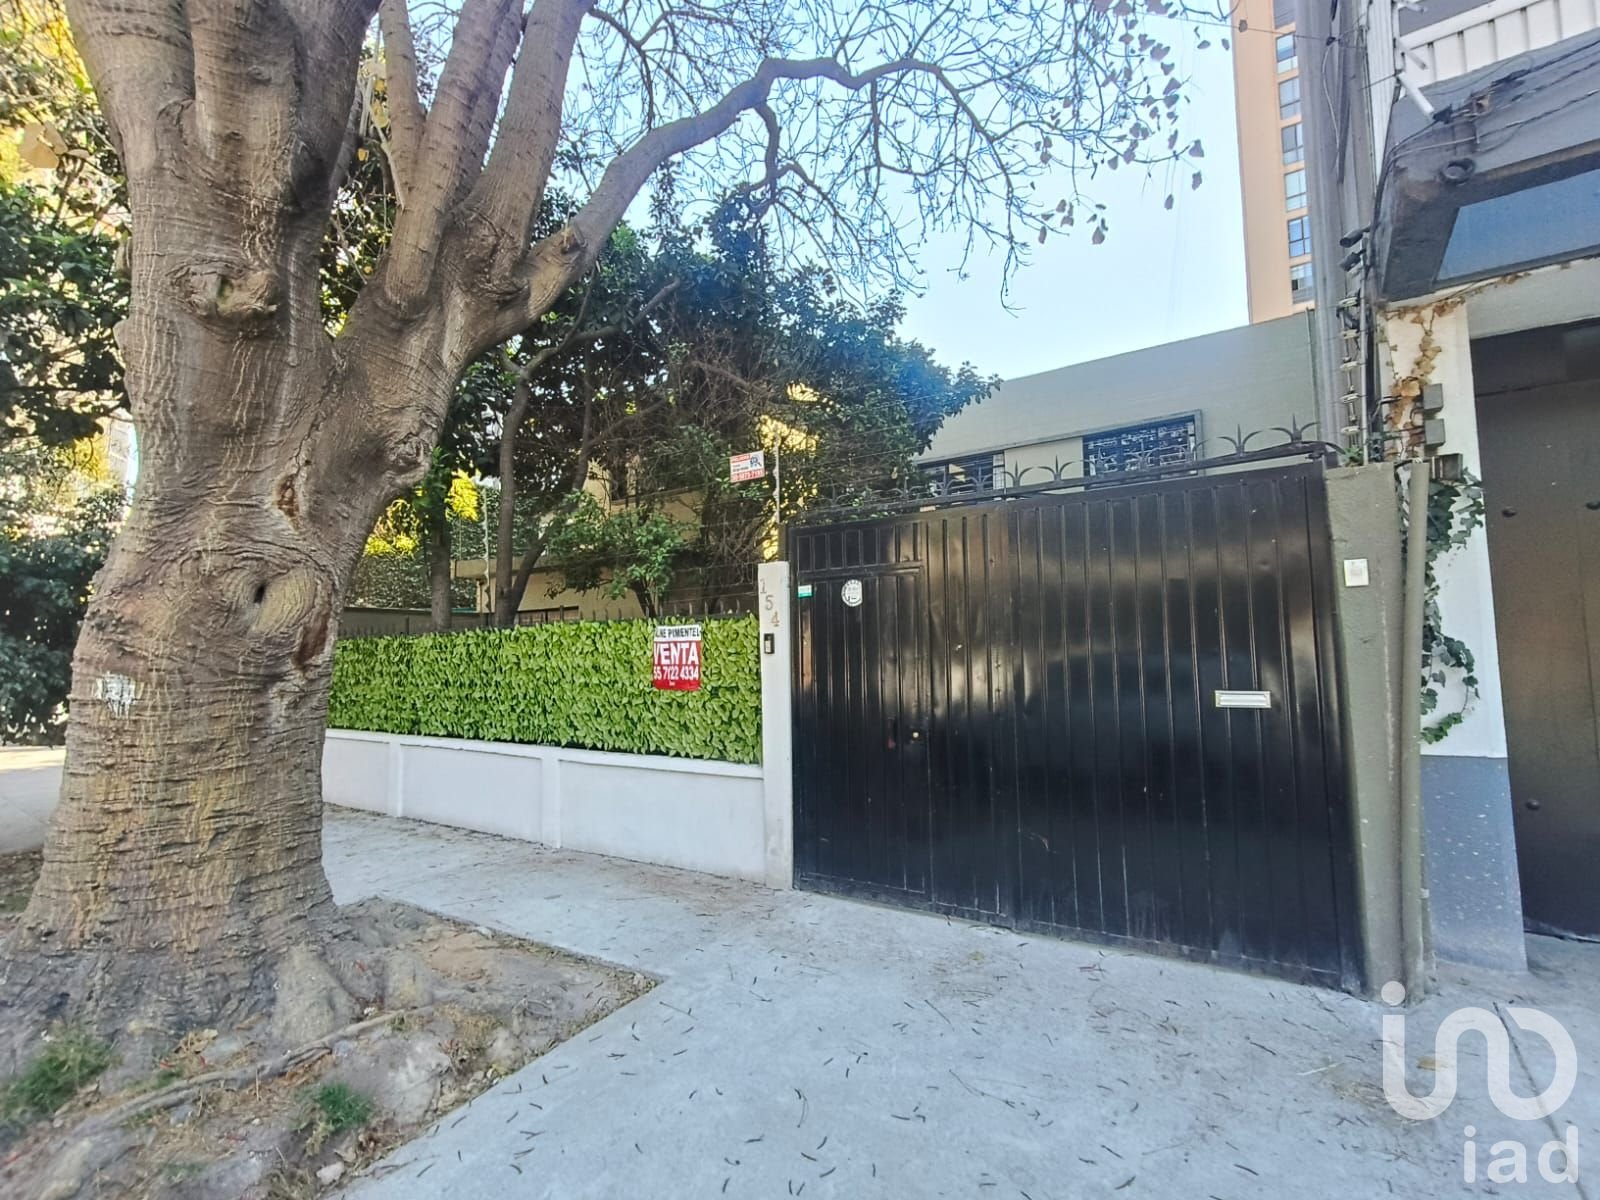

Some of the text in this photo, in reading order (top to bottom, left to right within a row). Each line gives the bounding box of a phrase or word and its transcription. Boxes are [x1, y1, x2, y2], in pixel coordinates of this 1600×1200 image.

[667, 627, 700, 638] PIMENTEL
[654, 642, 699, 665] VENTA
[680, 665, 700, 681] 4334
